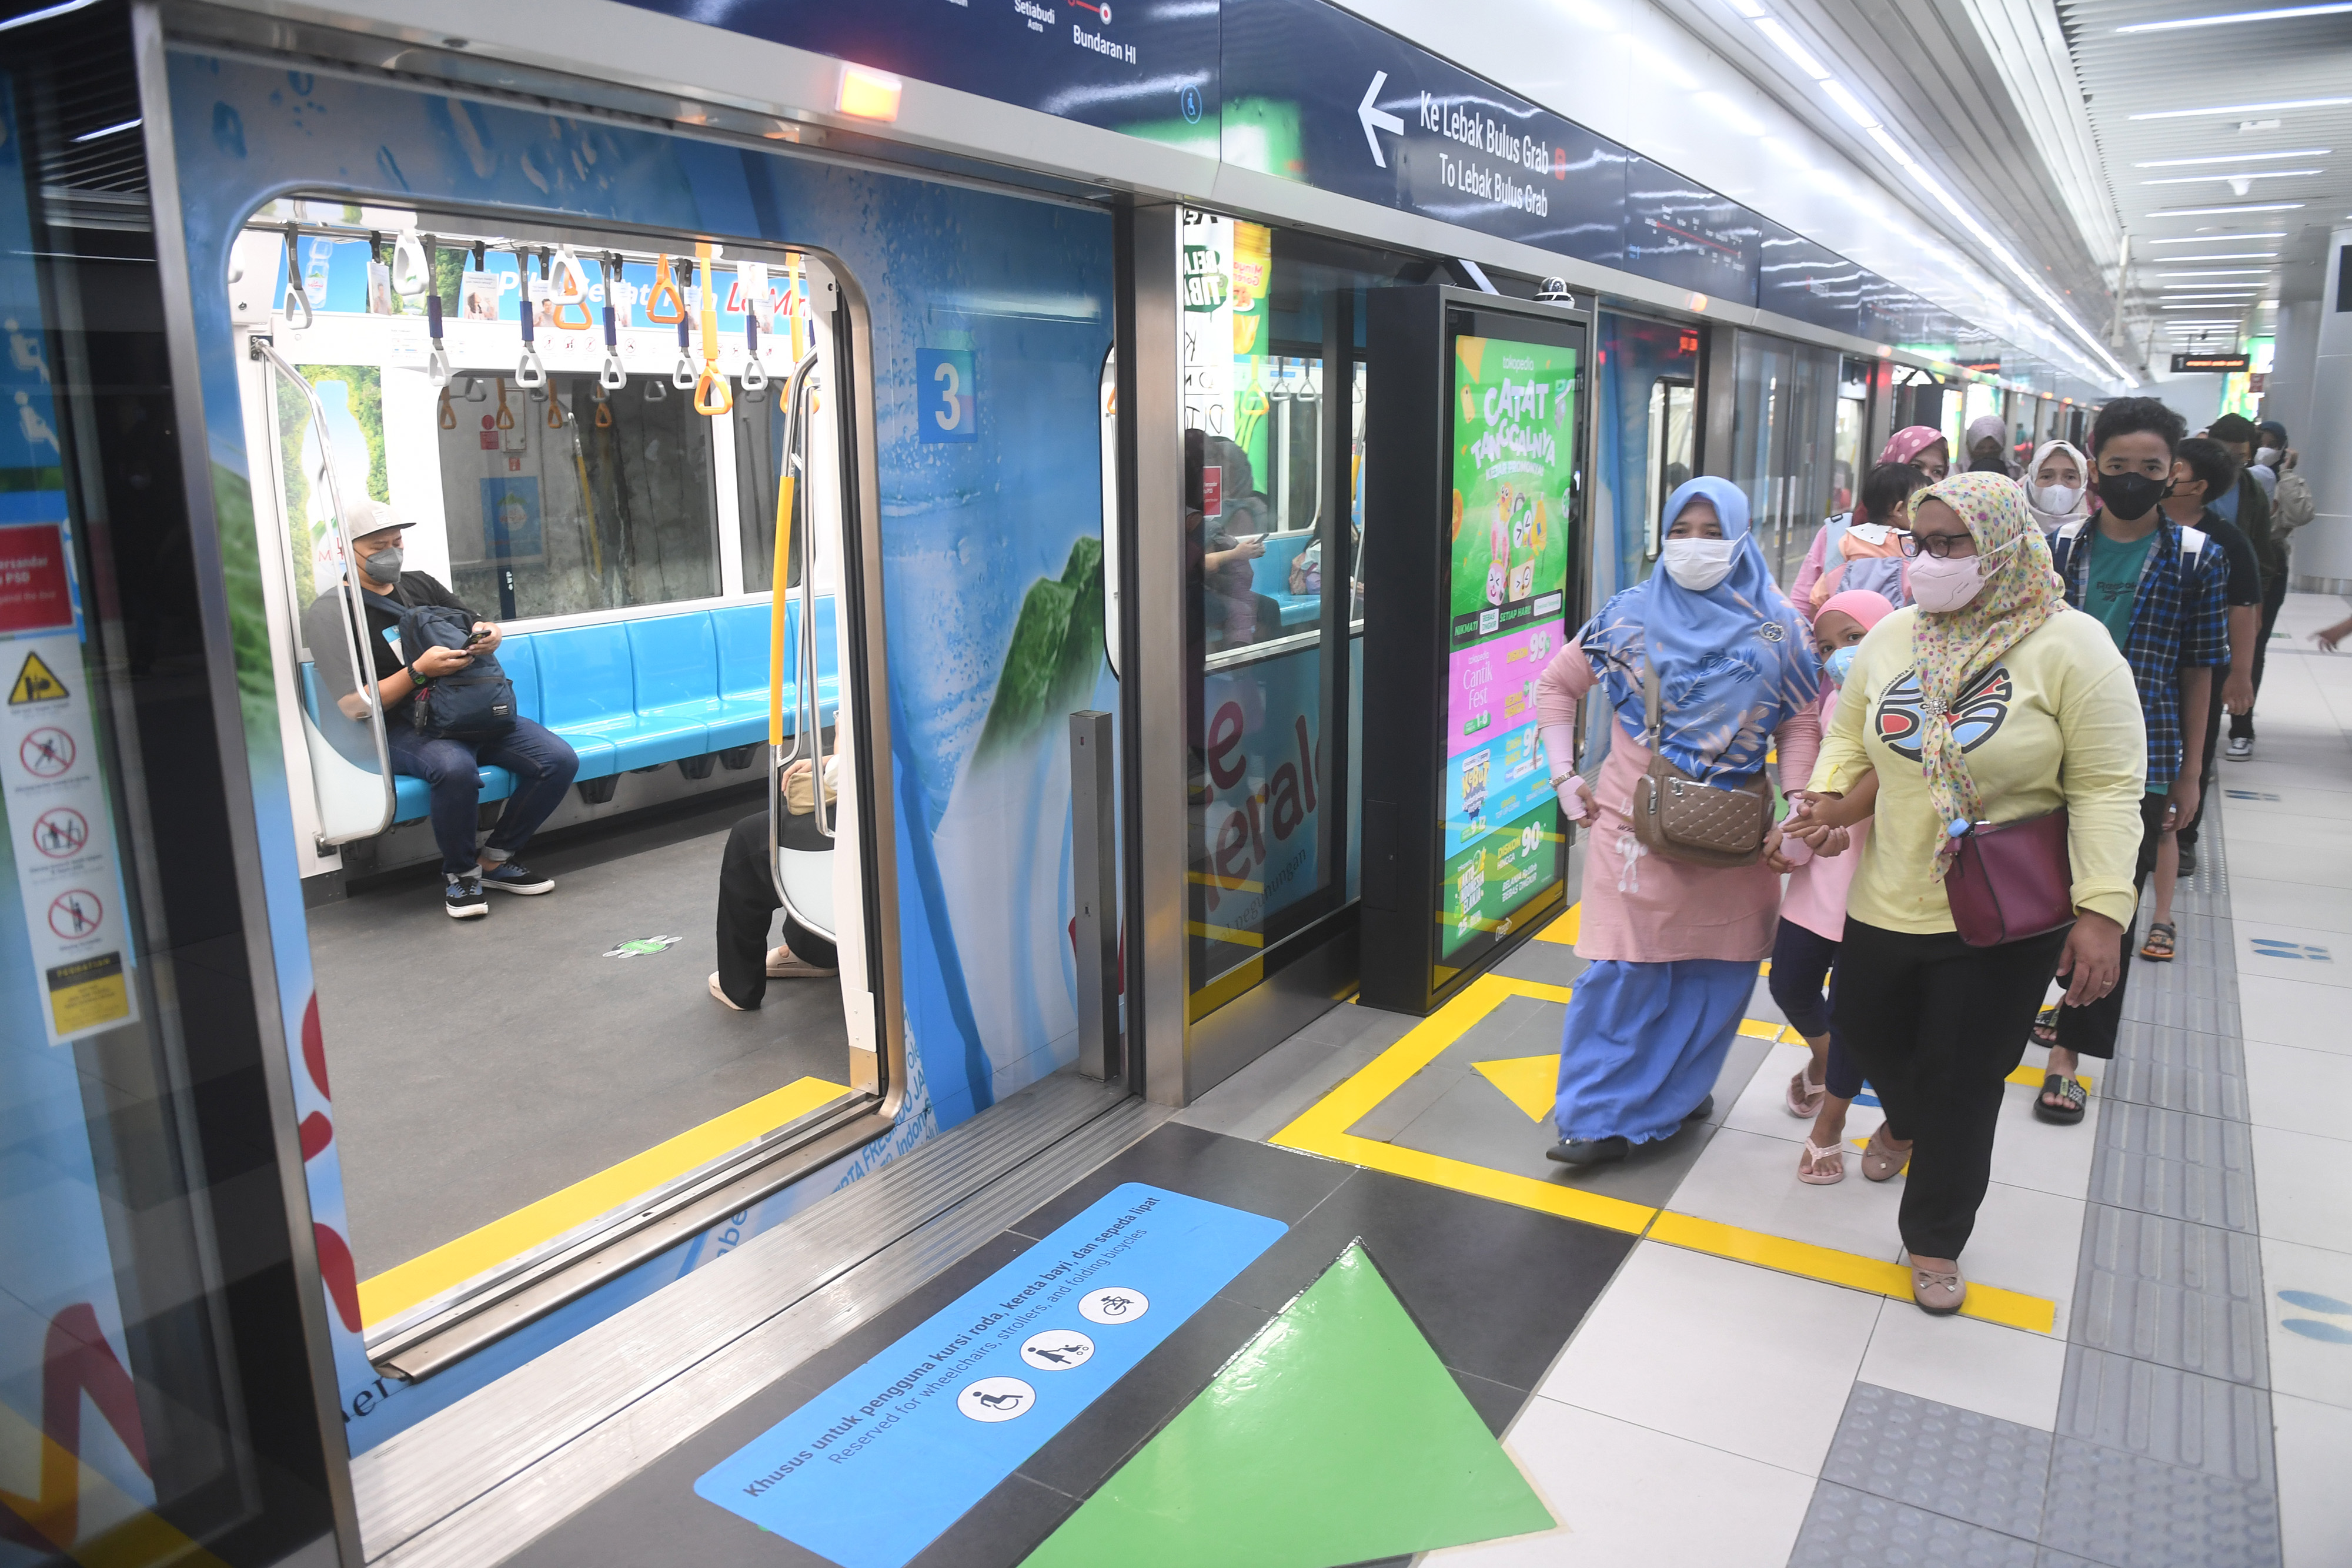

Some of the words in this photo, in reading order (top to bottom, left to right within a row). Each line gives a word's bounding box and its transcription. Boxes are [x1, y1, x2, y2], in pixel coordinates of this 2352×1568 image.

[1014, 0, 1055, 25] Setiabudi
[1027, 18, 1044, 33] Astra
[1074, 24, 1122, 61] Bundaran
[1125, 44, 1136, 65] HI
[1421, 90, 1439, 132] Ke
[1443, 101, 1484, 150] Lebak
[1486, 118, 1520, 163] Bulus
[1523, 135, 1549, 175] Grab
[1439, 152, 1455, 188] To
[1458, 159, 1492, 200] Lebak
[1494, 173, 1522, 210] Bulus
[1525, 184, 1548, 218] Grab
[934, 362, 961, 431] 3
[1484, 377, 1549, 427] CATAT
[1470, 417, 1555, 470] TANGGALNYA
[1463, 660, 1493, 690] Cantik
[1469, 686, 1488, 710] Fest
[1497, 852, 1516, 871] HINGGA
[1498, 835, 1522, 860] DISKON
[742, 1450, 814, 1497] Khusus
[811, 1414, 863, 1450] untuk
[858, 1361, 936, 1417] pengguna
[927, 1333, 973, 1362] kursi
[968, 1312, 1010, 1336] roda,
[998, 1280, 1048, 1310] kereta
[1038, 1260, 1079, 1281] bayi,
[1071, 1242, 1099, 1259] dan
[1094, 1214, 1137, 1243] sepeda
[1128, 1196, 1161, 1215] lipat
[827, 1413, 901, 1465] Reserved
[894, 1397, 922, 1414] for
[918, 1341, 1003, 1398] wheelchairs,
[997, 1303, 1053, 1340] strollers,
[1047, 1285, 1072, 1303] and
[1064, 1258, 1111, 1286] folding
[1100, 1229, 1147, 1259] bicycles
